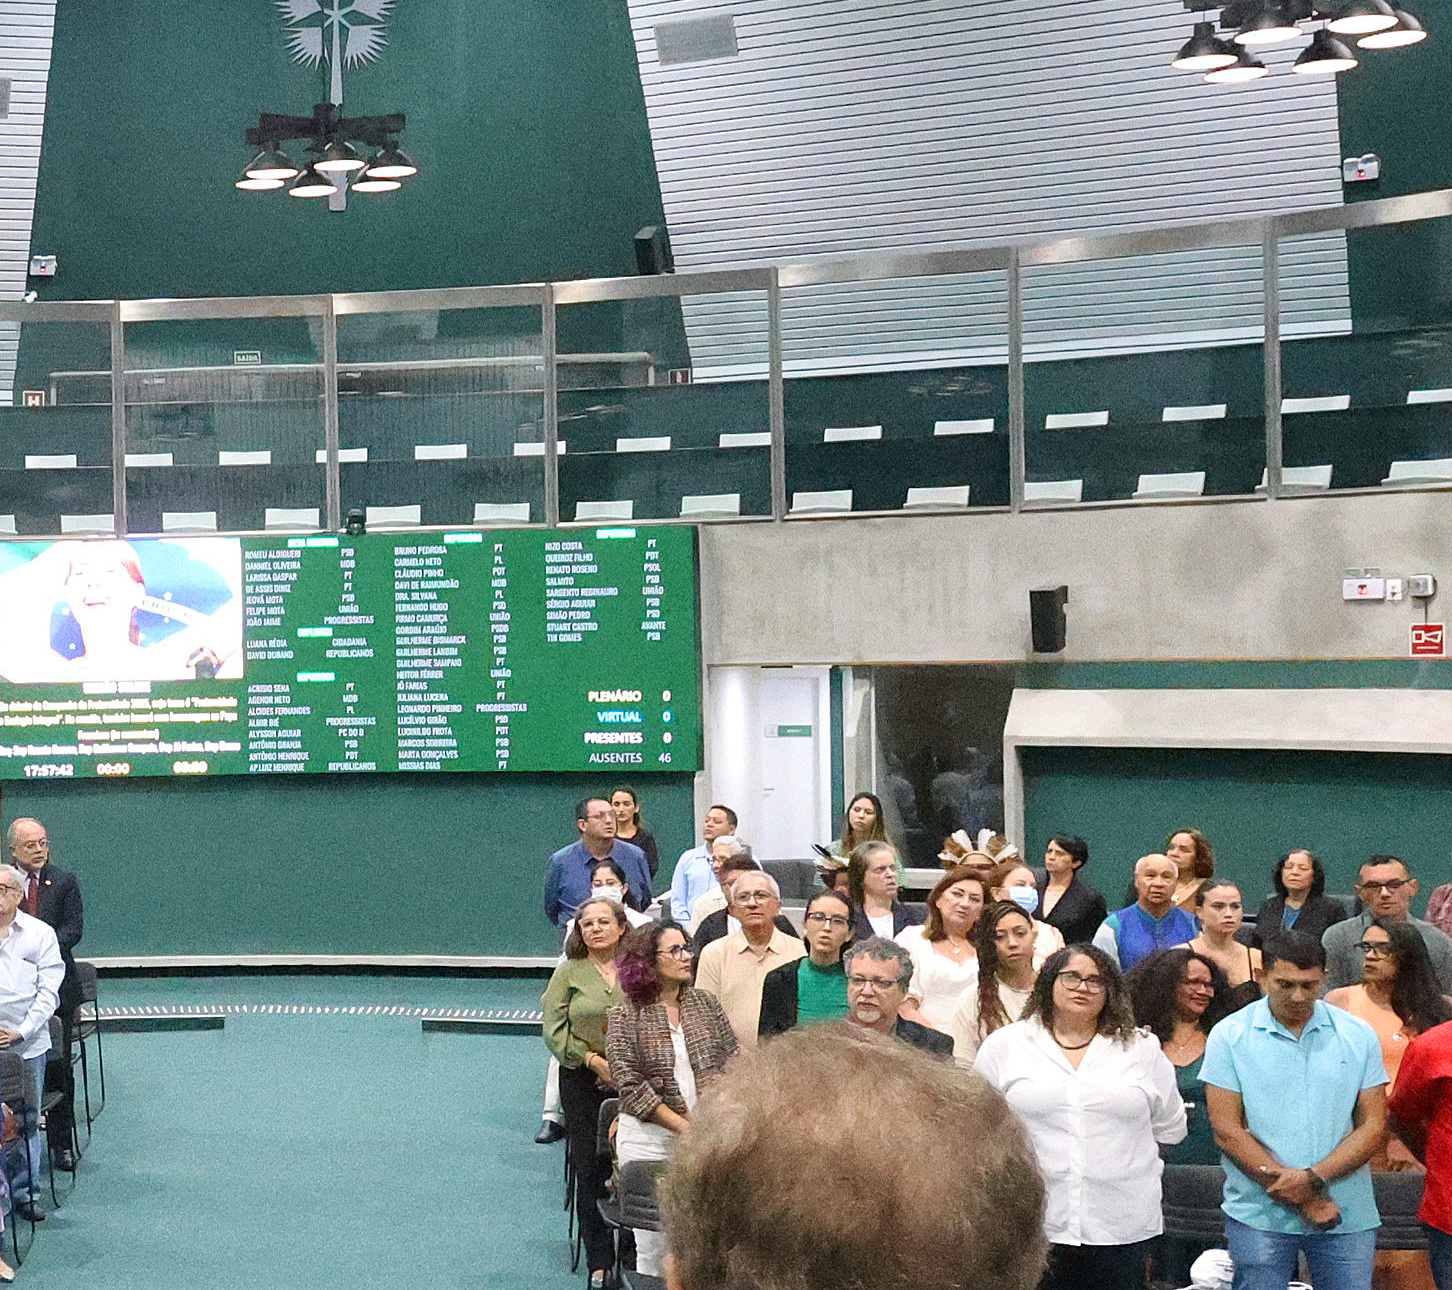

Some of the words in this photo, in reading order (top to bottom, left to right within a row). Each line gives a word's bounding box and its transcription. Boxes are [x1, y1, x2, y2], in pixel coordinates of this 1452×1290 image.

[587, 689, 643, 702] PLENÁRIO
[662, 690, 672, 702] 0
[597, 710, 642, 722] VIRTUAL
[662, 710, 672, 722] 0
[584, 732, 643, 744] PRESENTES
[662, 732, 672, 743] 0
[589, 753, 643, 763] AUSENTES
[658, 753, 672, 763] 46
[24, 764, 74, 777] 17:57:42
[95, 763, 130, 775] 00:00
